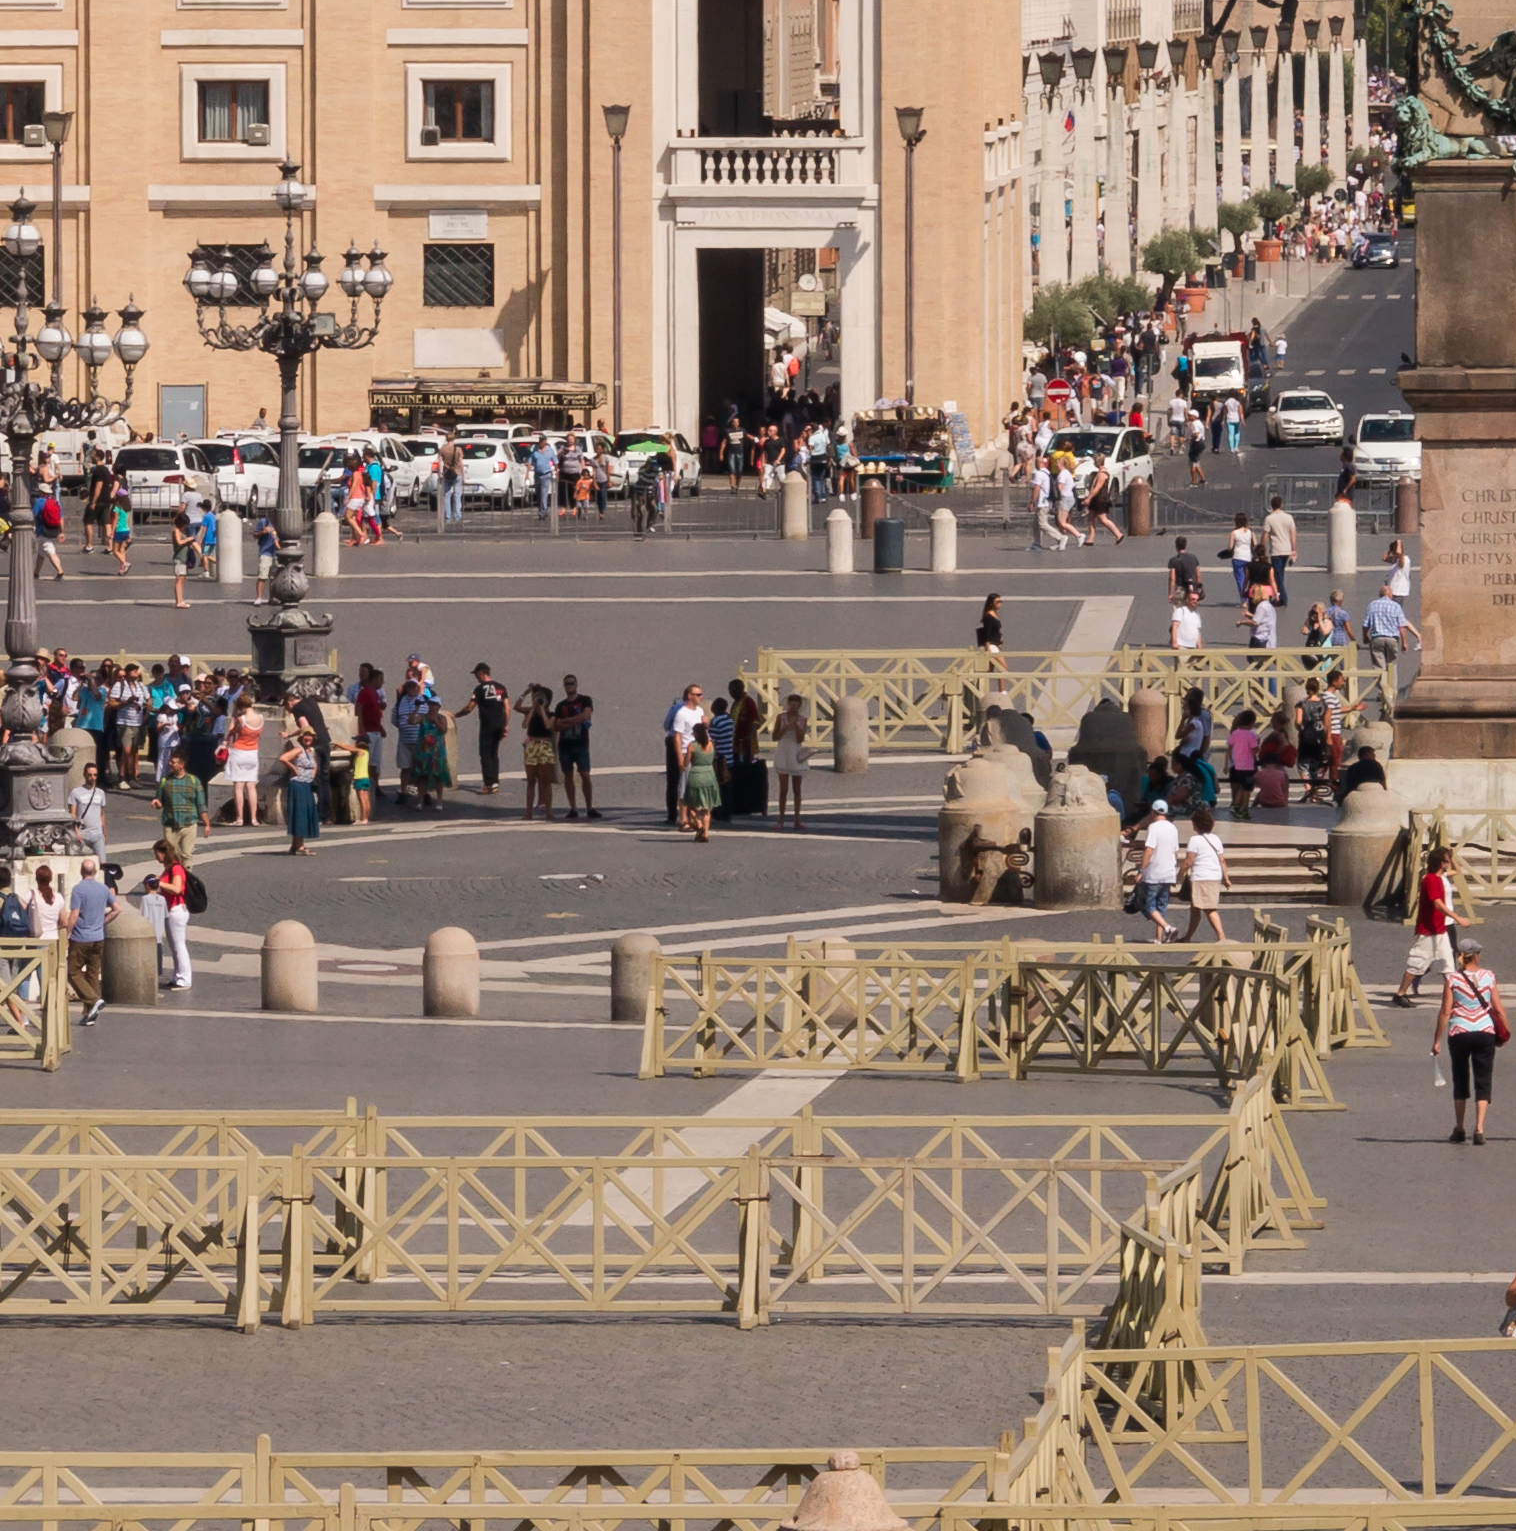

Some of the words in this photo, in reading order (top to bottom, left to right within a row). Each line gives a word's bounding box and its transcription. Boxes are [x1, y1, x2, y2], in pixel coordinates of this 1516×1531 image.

[373, 394, 423, 404] PATATINE
[429, 395, 499, 405] HAMBURGER
[1437, 552, 1513, 566] CHRISTVS
